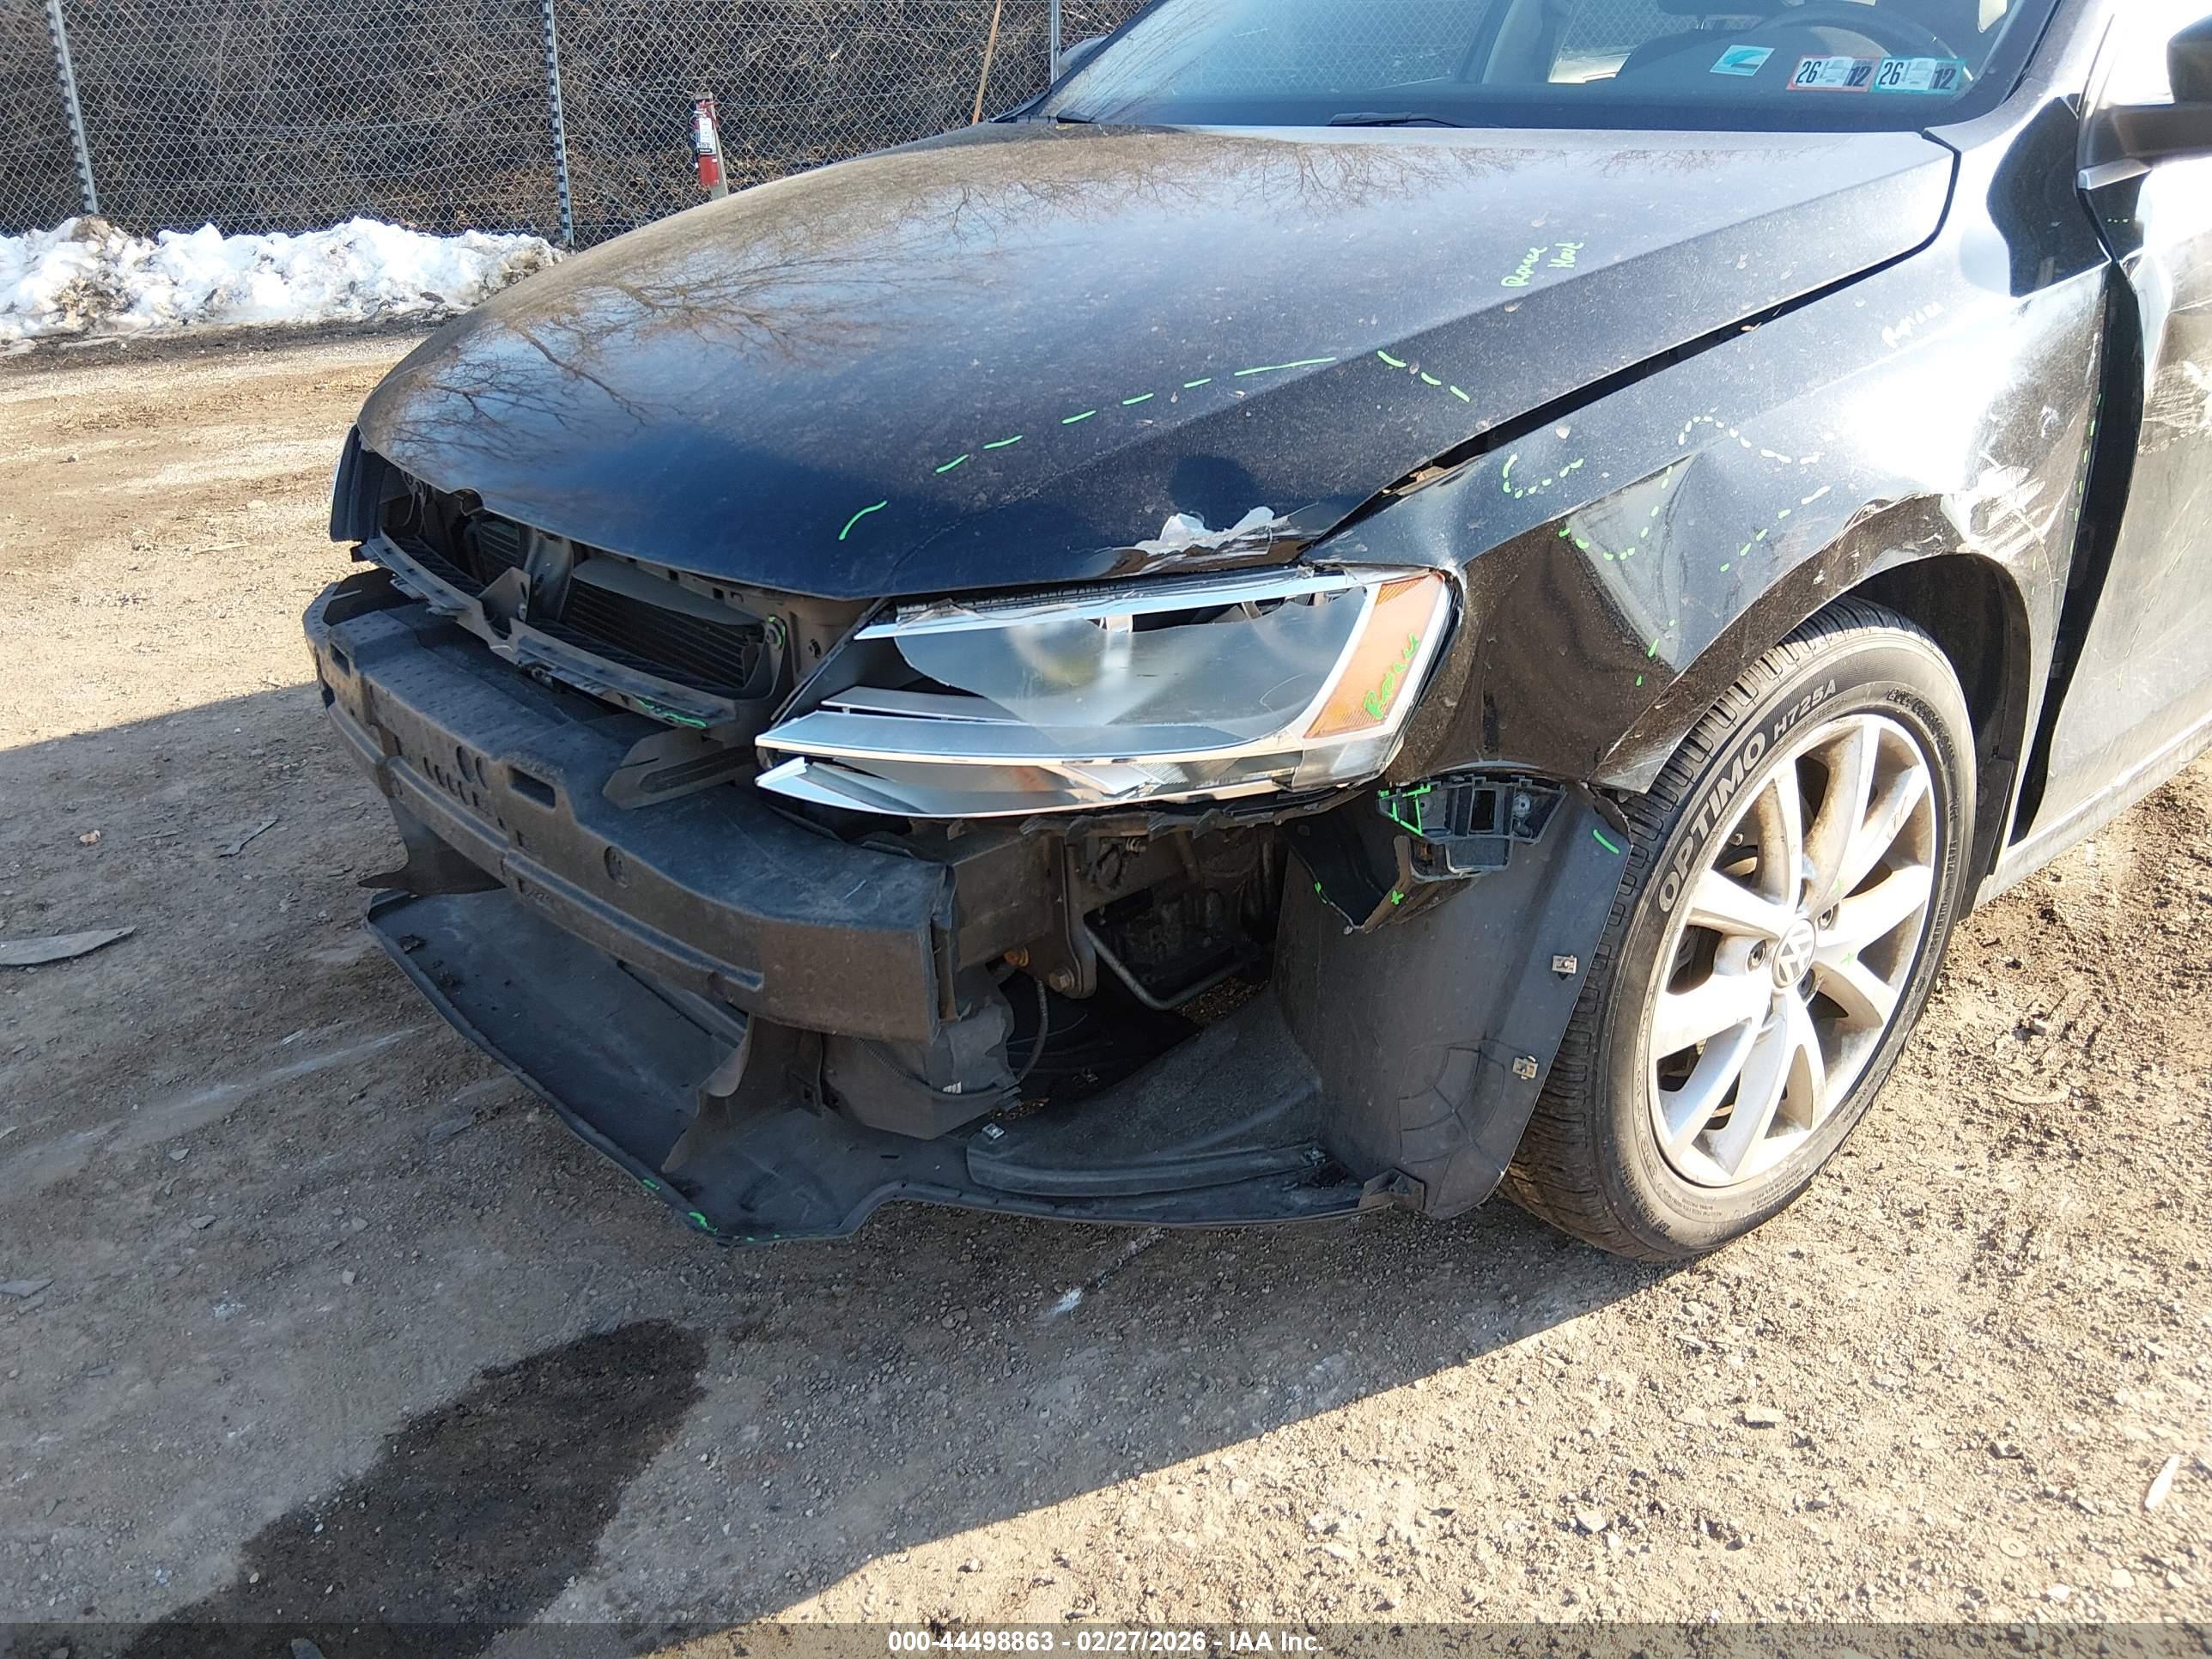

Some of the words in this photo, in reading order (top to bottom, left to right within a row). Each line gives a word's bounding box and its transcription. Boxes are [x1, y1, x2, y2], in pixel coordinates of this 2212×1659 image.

[1795, 61, 1822, 83] 26
[1846, 66, 1872, 87] 12
[1878, 62, 1904, 85] 26
[1933, 69, 1957, 89] 12
[1658, 732, 1766, 913] OPTIMO
[1773, 679, 1836, 742] H725A
